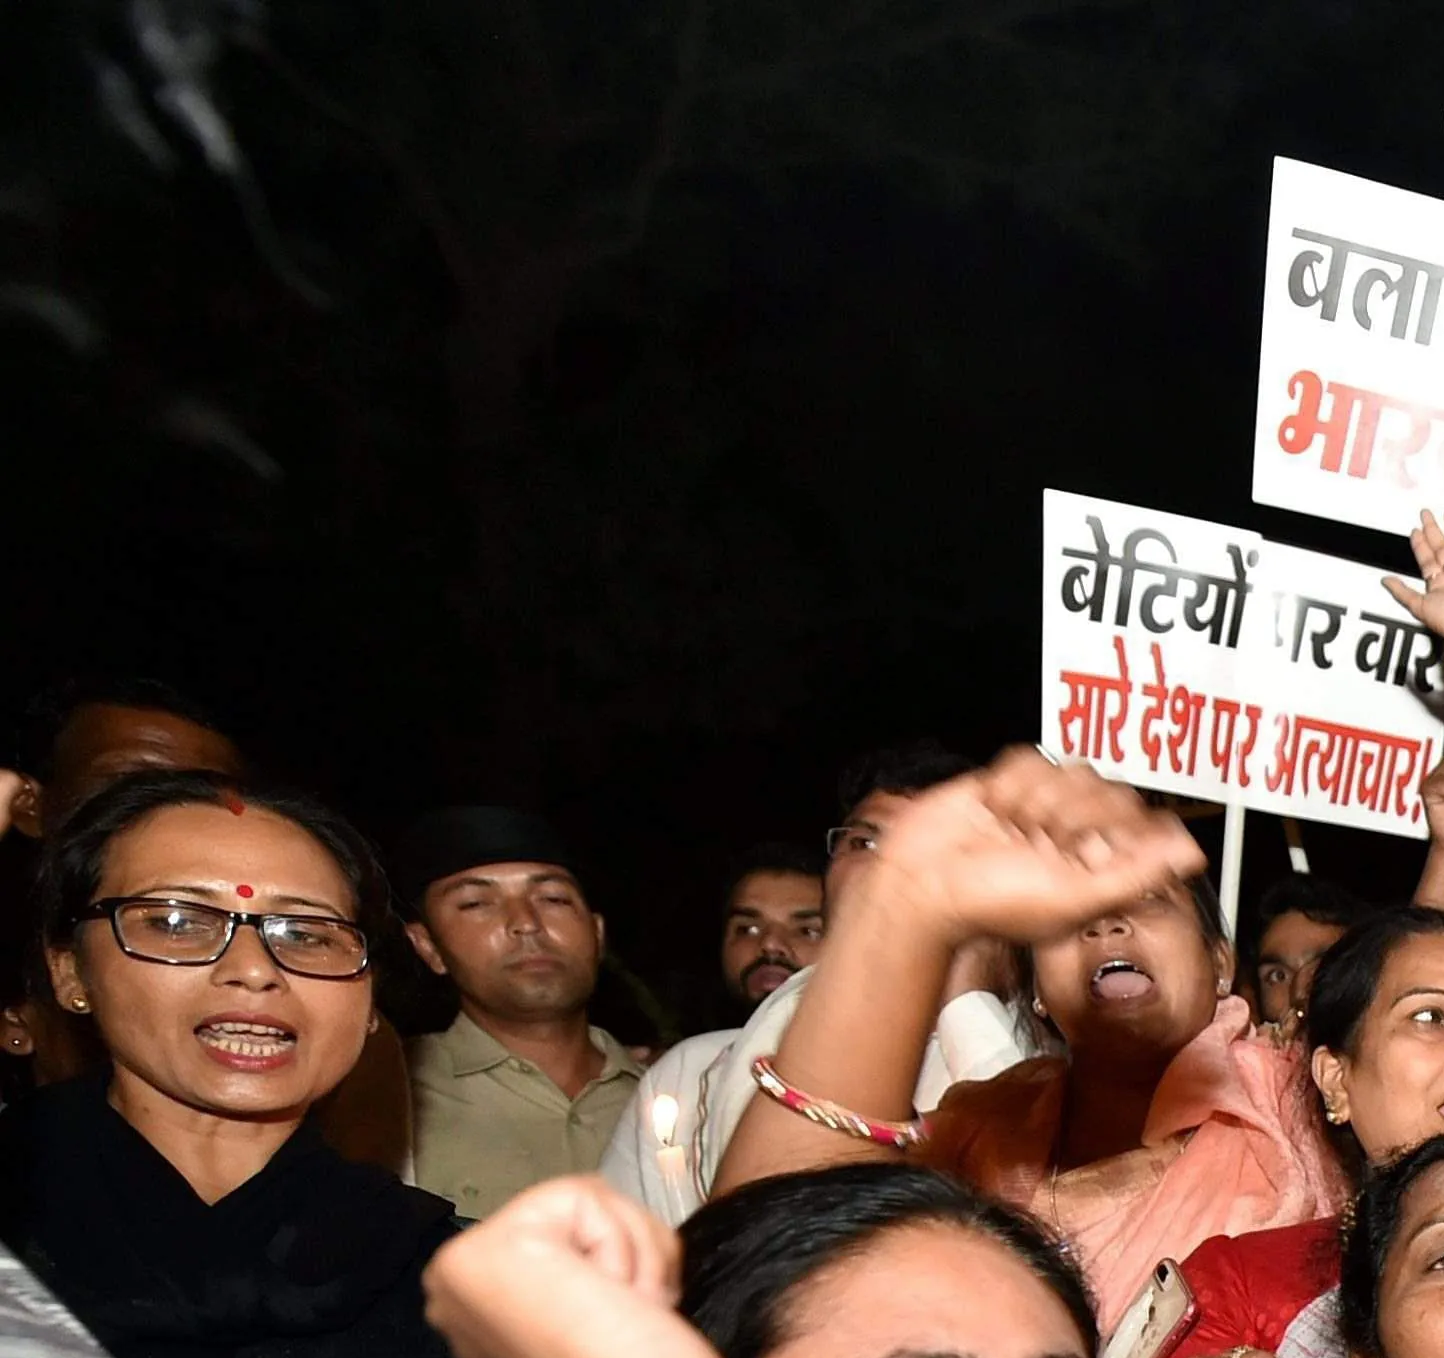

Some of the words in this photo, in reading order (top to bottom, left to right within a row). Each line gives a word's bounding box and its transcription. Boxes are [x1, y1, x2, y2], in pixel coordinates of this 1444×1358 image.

[1060, 515, 1259, 649] बेटियों
[1058, 635, 1132, 764] सारे
[1139, 641, 1206, 777] देश
[1210, 695, 1262, 788] पर
[1264, 712, 1434, 825] अत्याचार!
